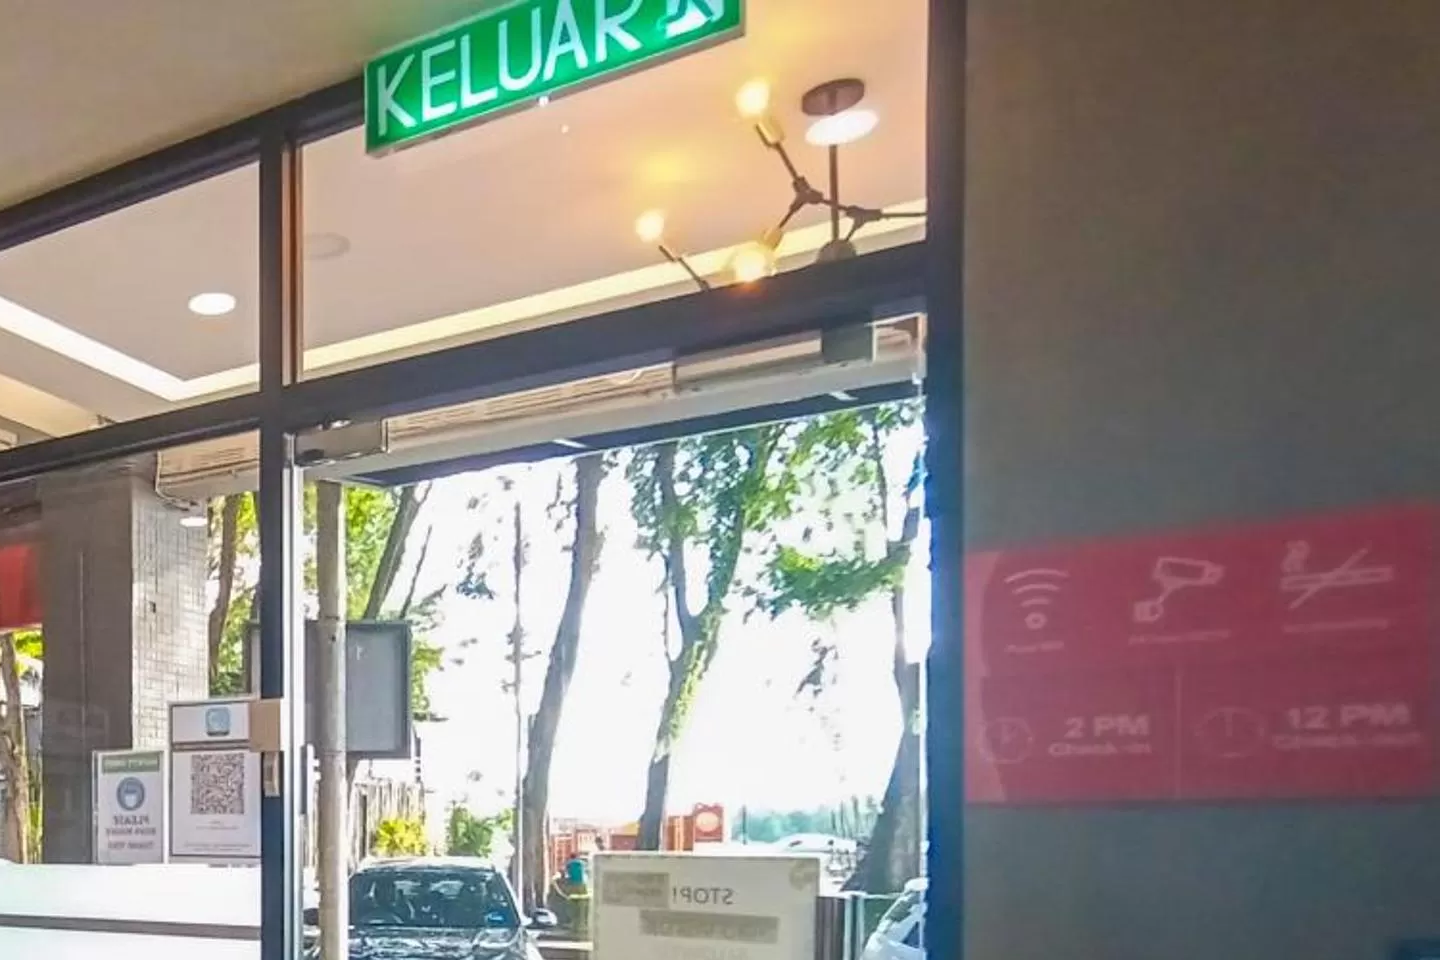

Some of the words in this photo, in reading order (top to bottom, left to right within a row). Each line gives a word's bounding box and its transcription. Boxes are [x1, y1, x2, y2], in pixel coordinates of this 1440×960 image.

[377, 0, 642, 137] KELUAR
[1064, 715, 1085, 739] 2
[1092, 714, 1150, 737] PM
[1286, 706, 1329, 729] 12
[1340, 702, 1410, 727] PM
